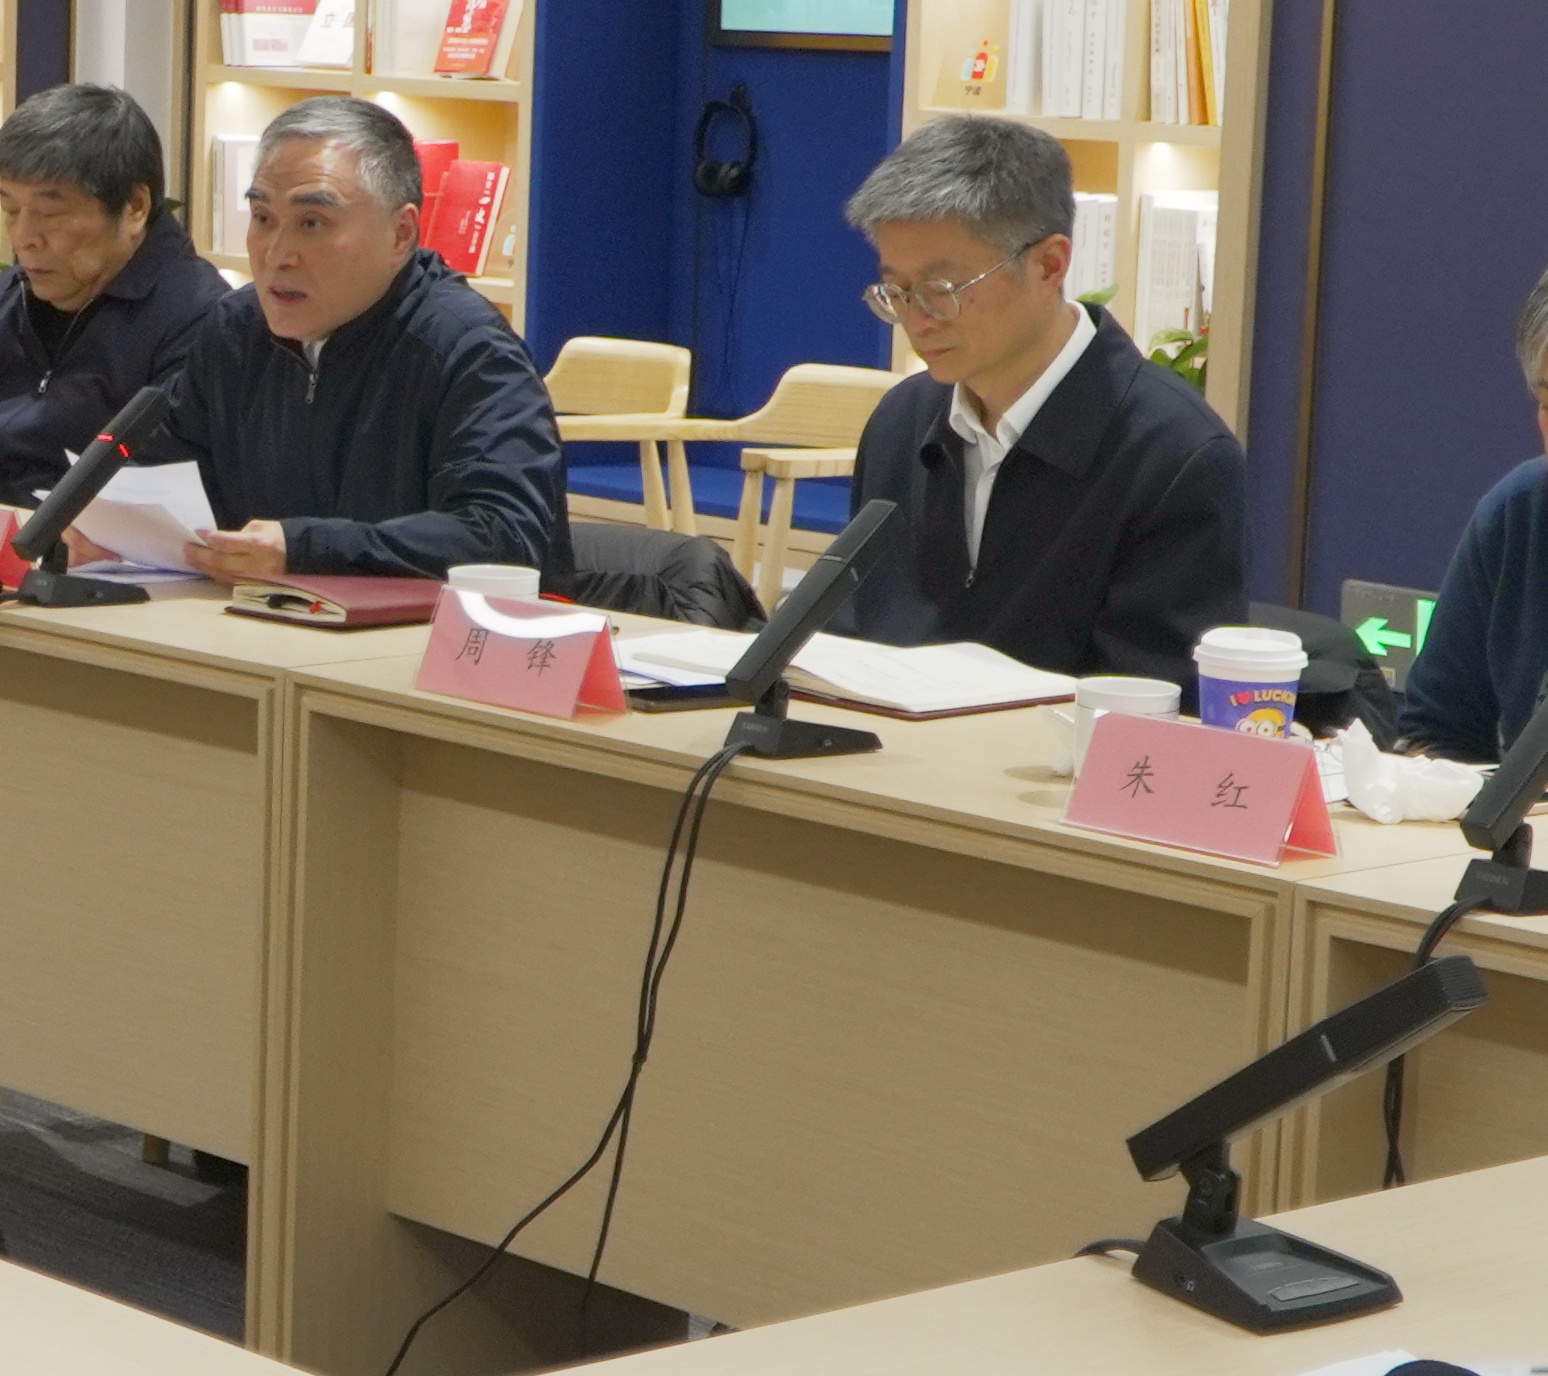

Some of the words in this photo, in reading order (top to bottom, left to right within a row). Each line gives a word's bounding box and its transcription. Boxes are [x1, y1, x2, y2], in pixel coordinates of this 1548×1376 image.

[454, 627, 558, 676] 周锋
[1229, 695, 1239, 707] I
[1120, 755, 1250, 811] 朱红
